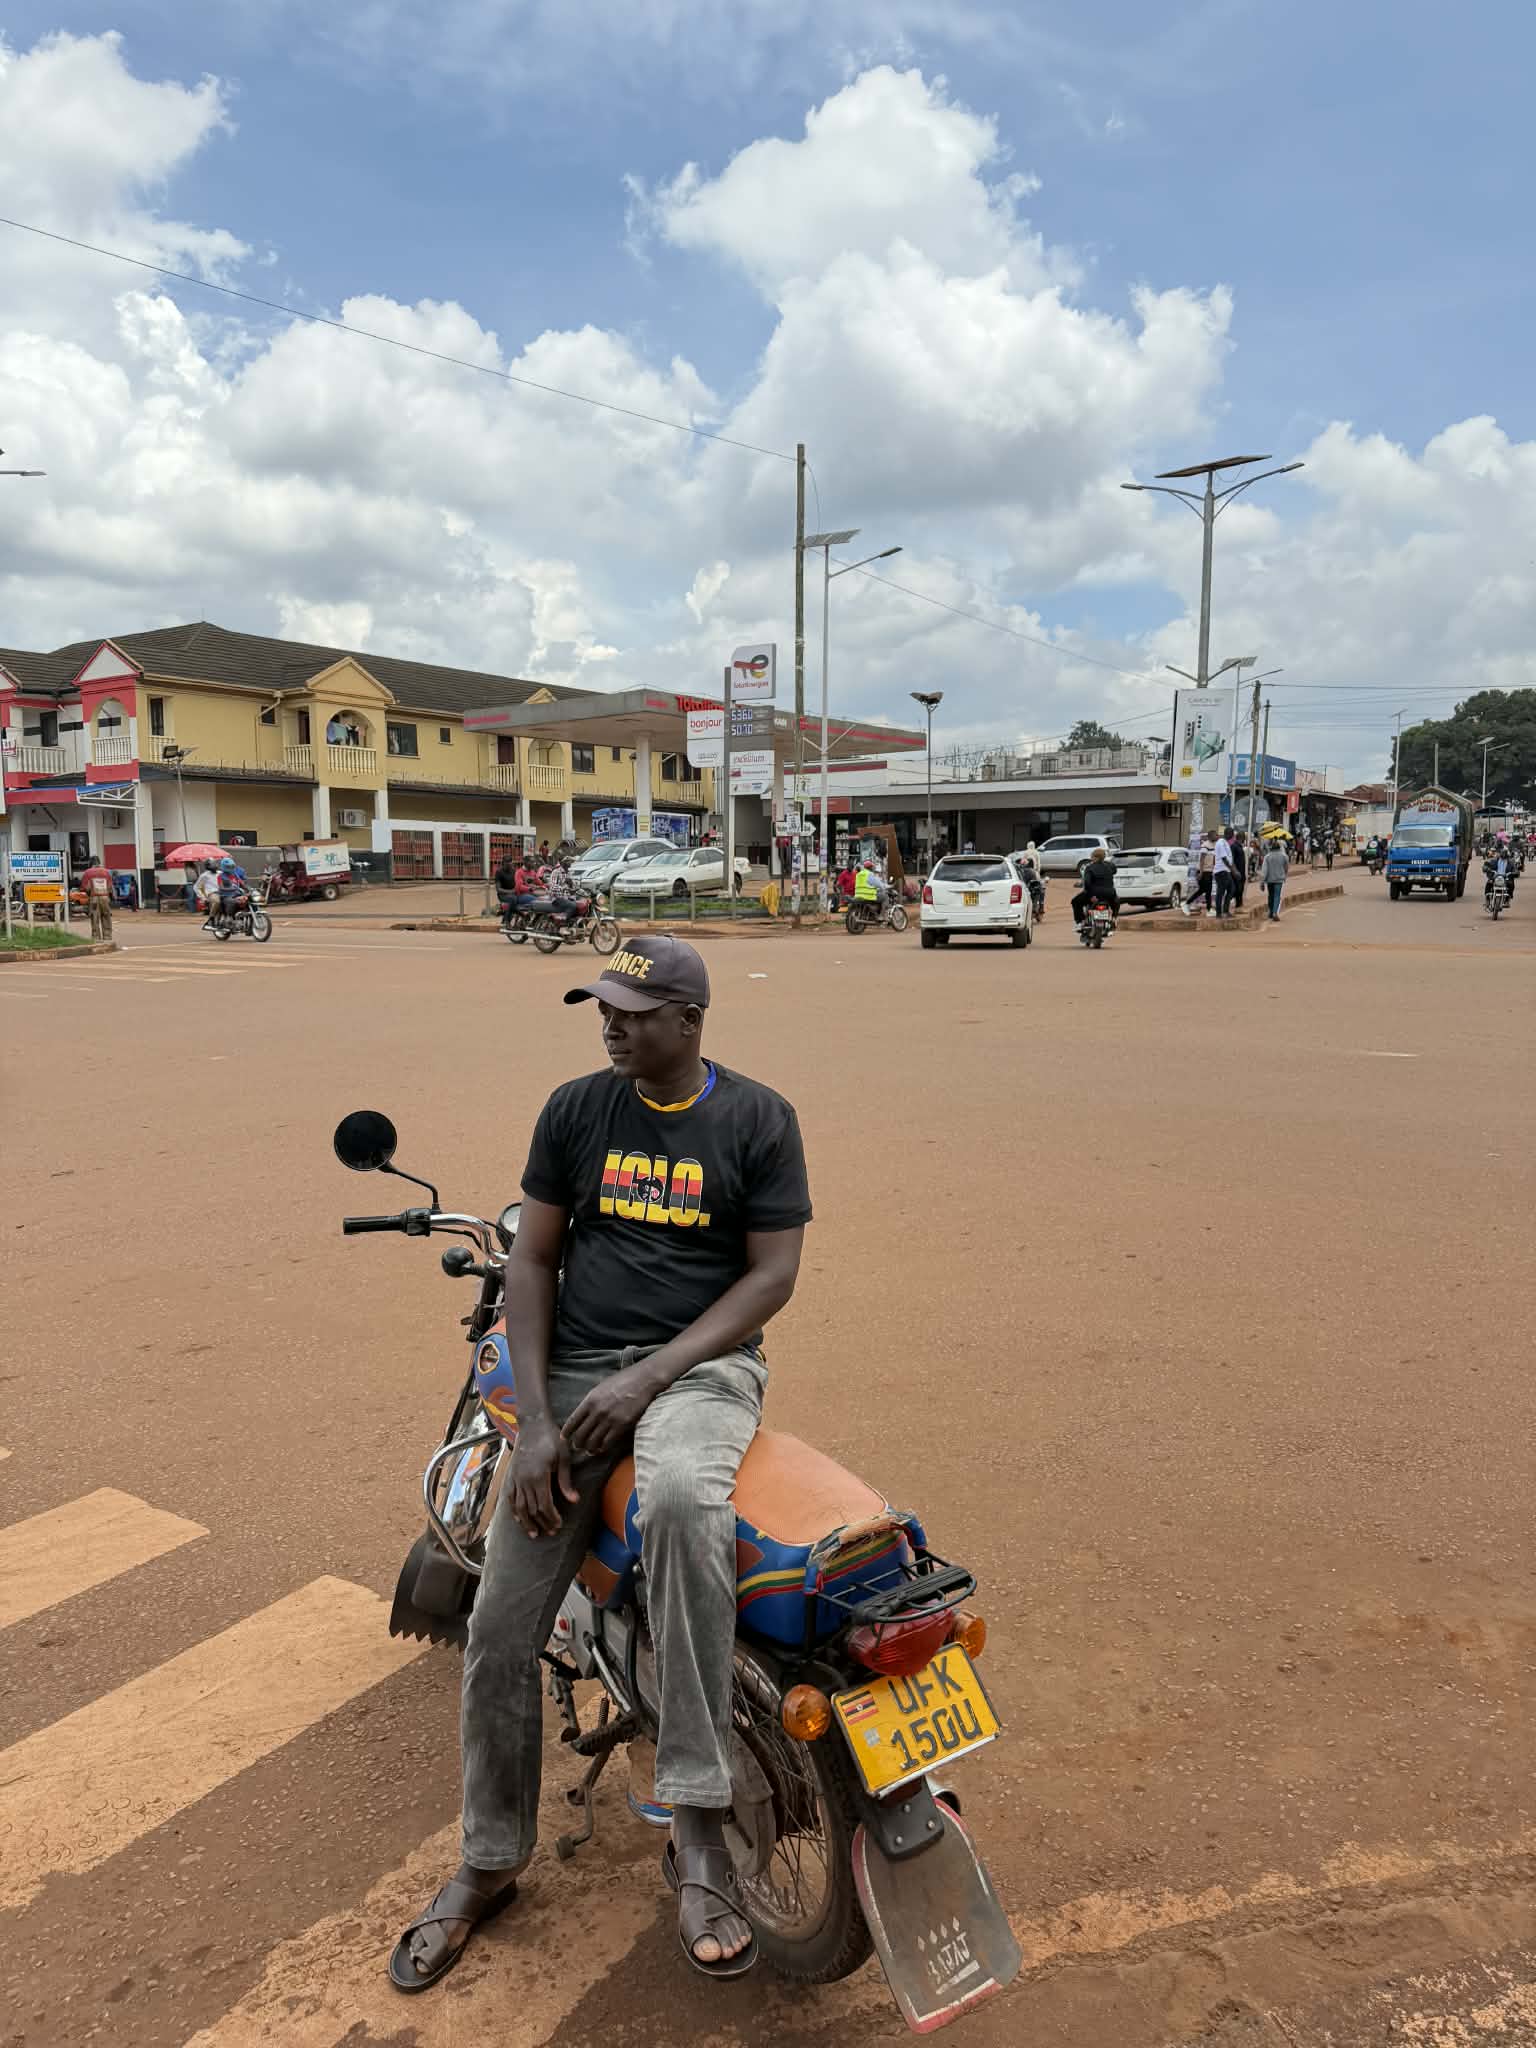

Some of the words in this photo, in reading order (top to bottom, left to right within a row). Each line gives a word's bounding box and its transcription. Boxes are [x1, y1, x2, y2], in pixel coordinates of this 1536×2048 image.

[690, 716, 722, 731] bonjour
[888, 1655, 964, 1715] UFK
[891, 1698, 983, 1770] 150U
